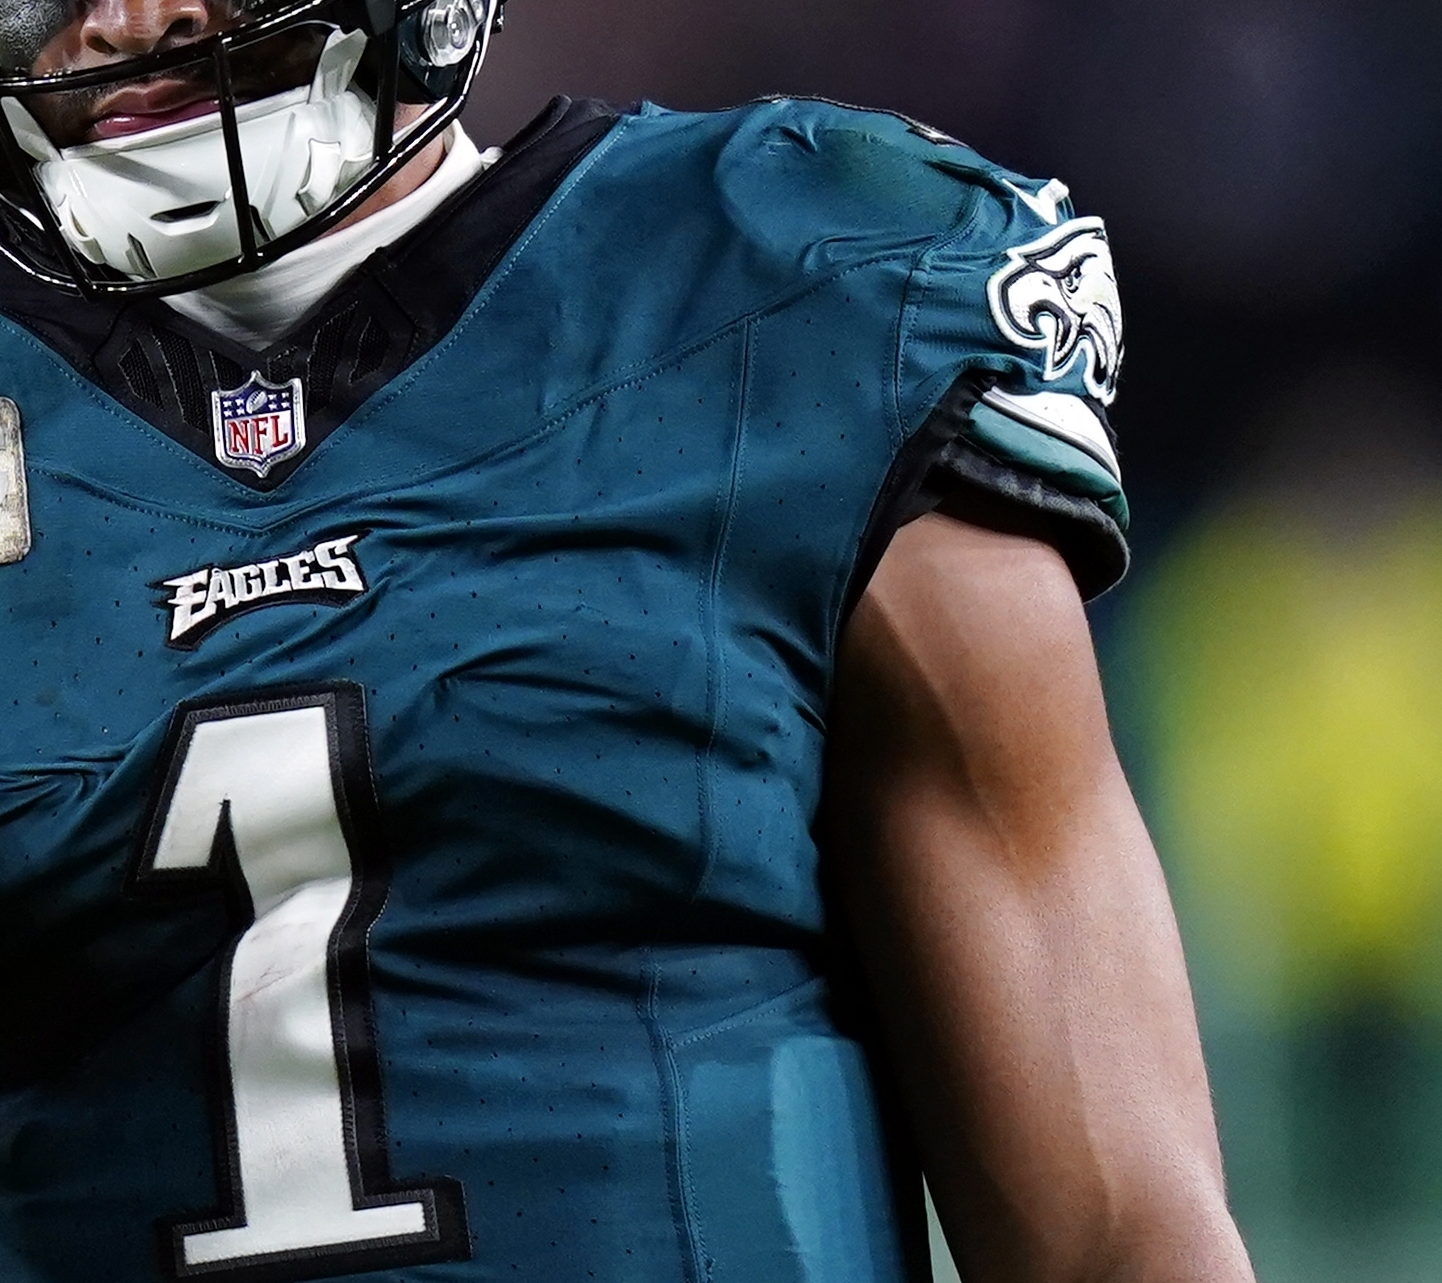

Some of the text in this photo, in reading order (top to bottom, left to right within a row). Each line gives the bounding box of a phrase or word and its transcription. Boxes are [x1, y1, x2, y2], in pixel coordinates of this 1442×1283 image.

[228, 415, 289, 455] NFL
[162, 534, 365, 641] EAGLES
[146, 702, 434, 1273] 1
